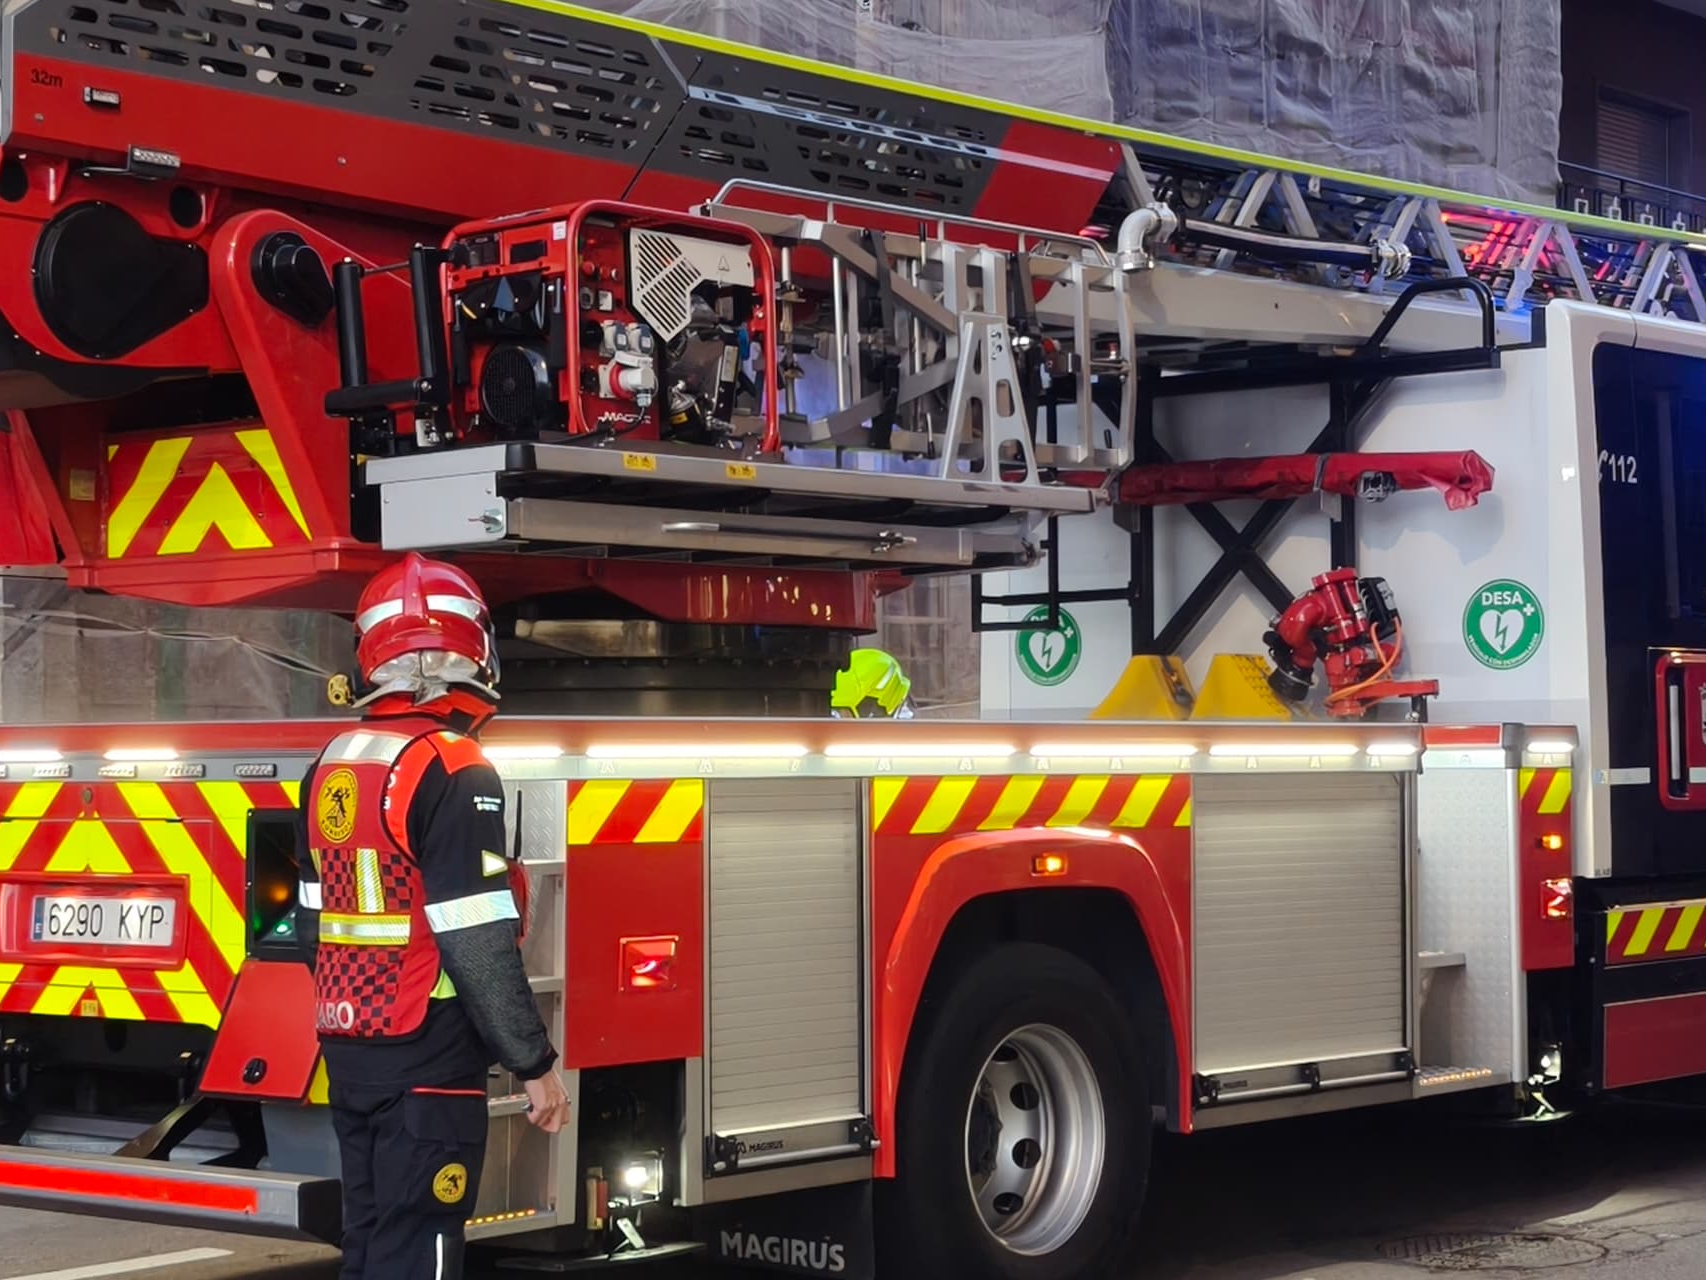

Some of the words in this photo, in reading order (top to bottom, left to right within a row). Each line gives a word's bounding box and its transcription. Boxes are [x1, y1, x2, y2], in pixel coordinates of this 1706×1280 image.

[1607, 453, 1638, 484] 112
[1480, 590, 1525, 607] DESA
[48, 903, 103, 936] 6290
[118, 905, 164, 940] KYP
[317, 1000, 355, 1030] ABO
[748, 1139, 784, 1153] MAGIRUS
[720, 1230, 847, 1273] MAGIRUS
